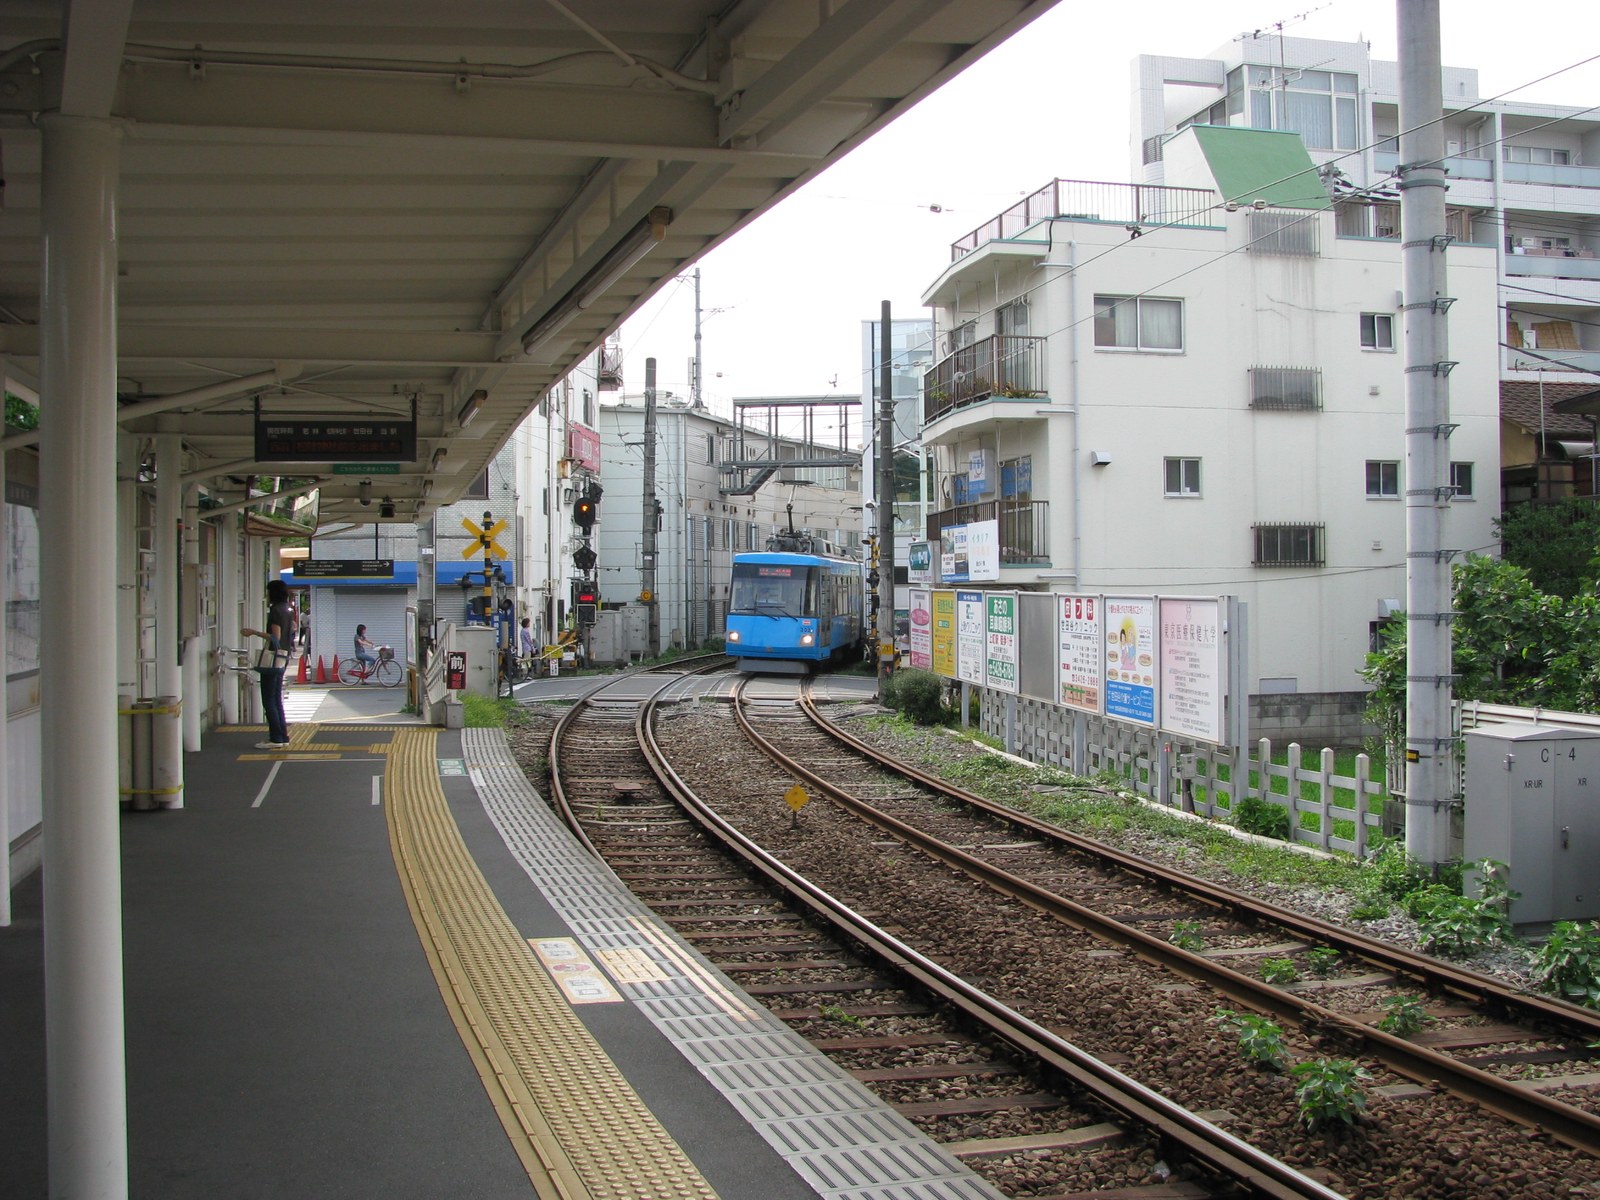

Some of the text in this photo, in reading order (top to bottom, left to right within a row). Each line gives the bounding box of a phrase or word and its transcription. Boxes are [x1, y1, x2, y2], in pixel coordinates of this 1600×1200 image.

[1164, 622, 1216, 643] 東京医療保健大学
